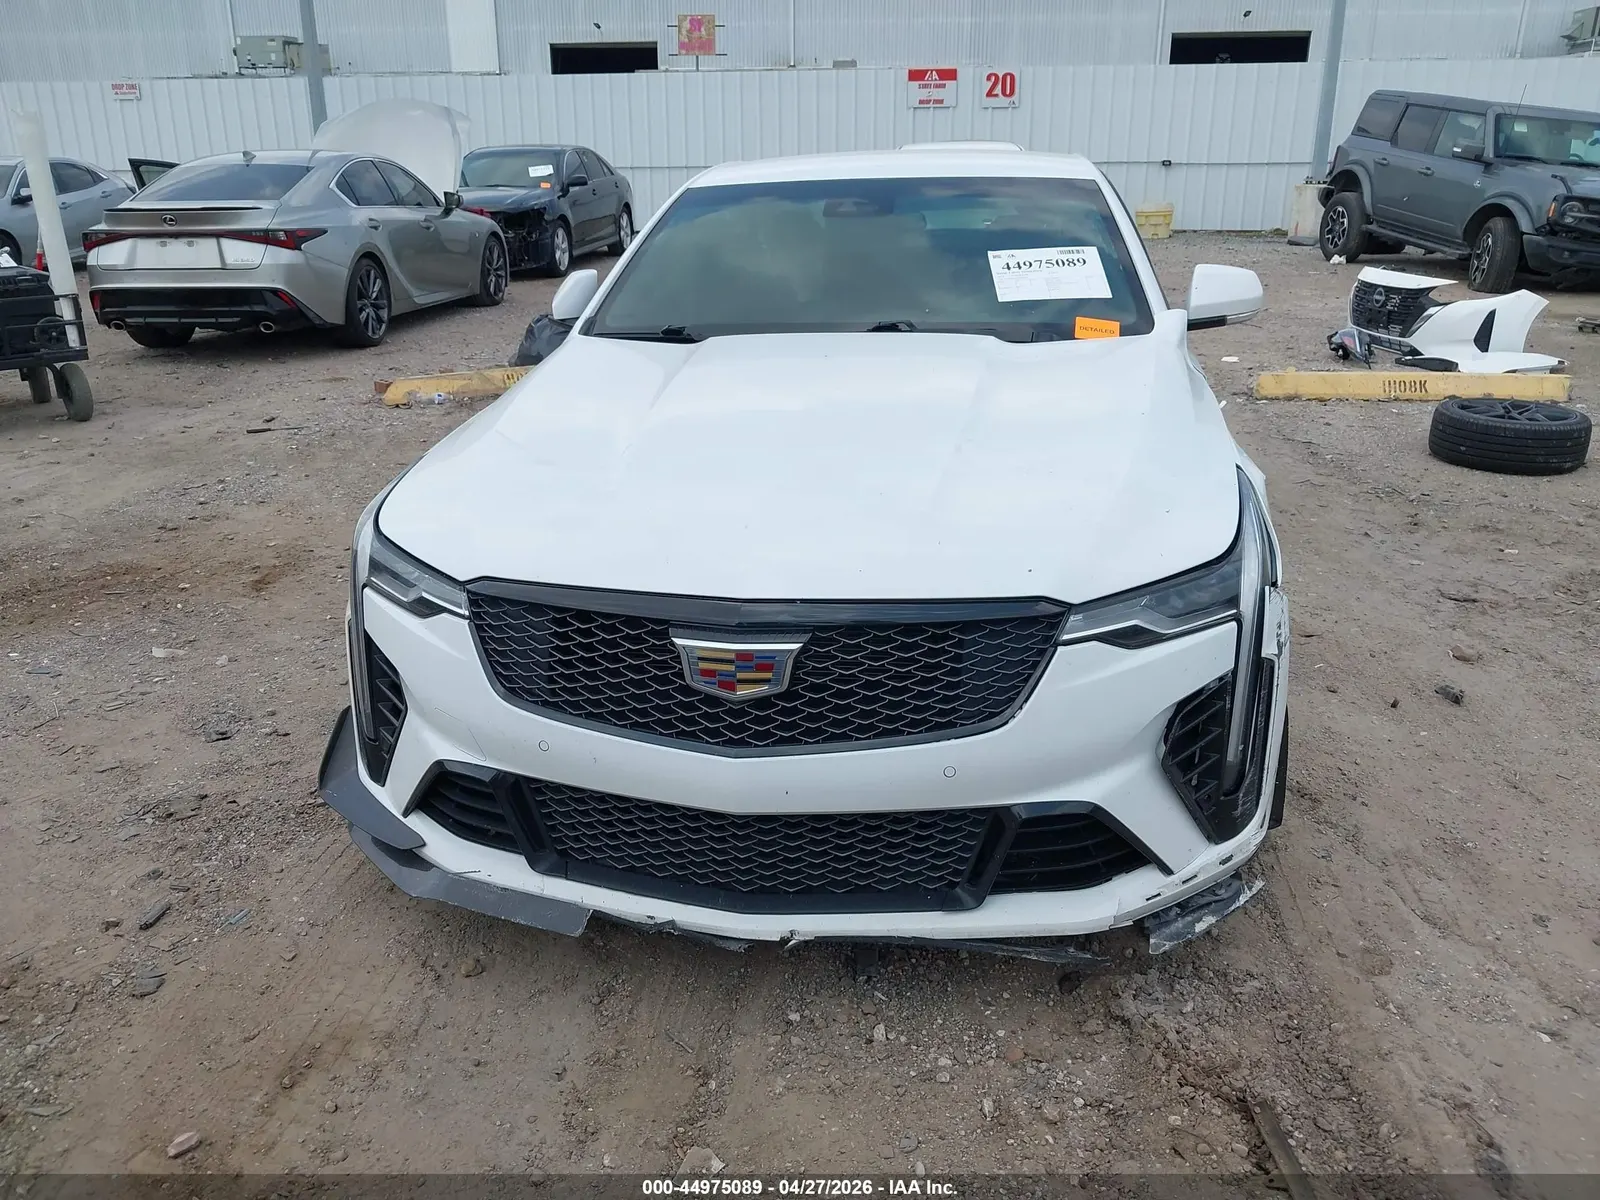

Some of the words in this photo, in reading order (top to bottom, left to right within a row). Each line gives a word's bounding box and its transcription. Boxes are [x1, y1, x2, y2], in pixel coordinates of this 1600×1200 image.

[986, 72, 1016, 98] 20
[1002, 257, 1087, 271] 44975089
[1079, 325, 1115, 334] DETAILED
